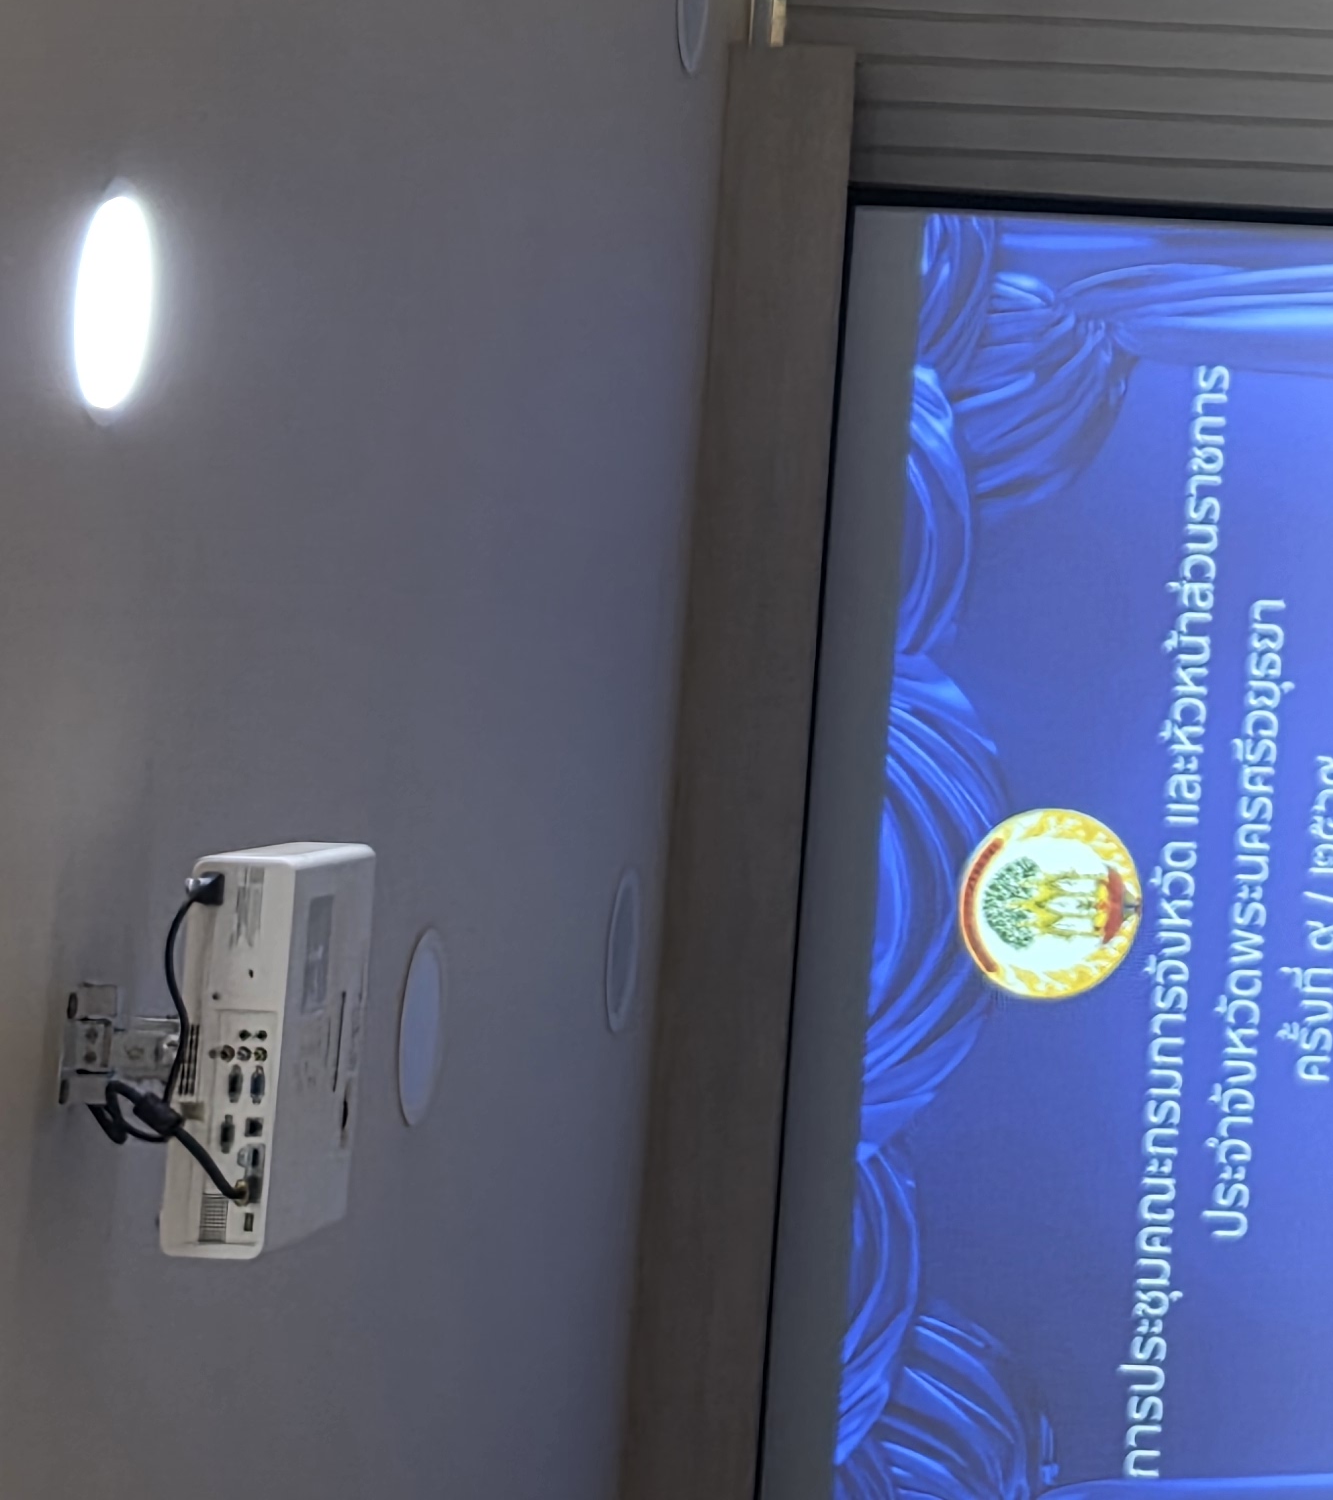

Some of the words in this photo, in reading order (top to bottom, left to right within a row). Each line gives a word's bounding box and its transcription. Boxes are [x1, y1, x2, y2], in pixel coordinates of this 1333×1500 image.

[1118, 840, 1197, 1477] การประชุมคณะกรมการจังหวัด
[1159, 366, 1230, 825] และหัวหน้าส่วนราชการ
[1202, 598, 1294, 1238] ประจำจังหวัดพระนครศรีอยุธยา
